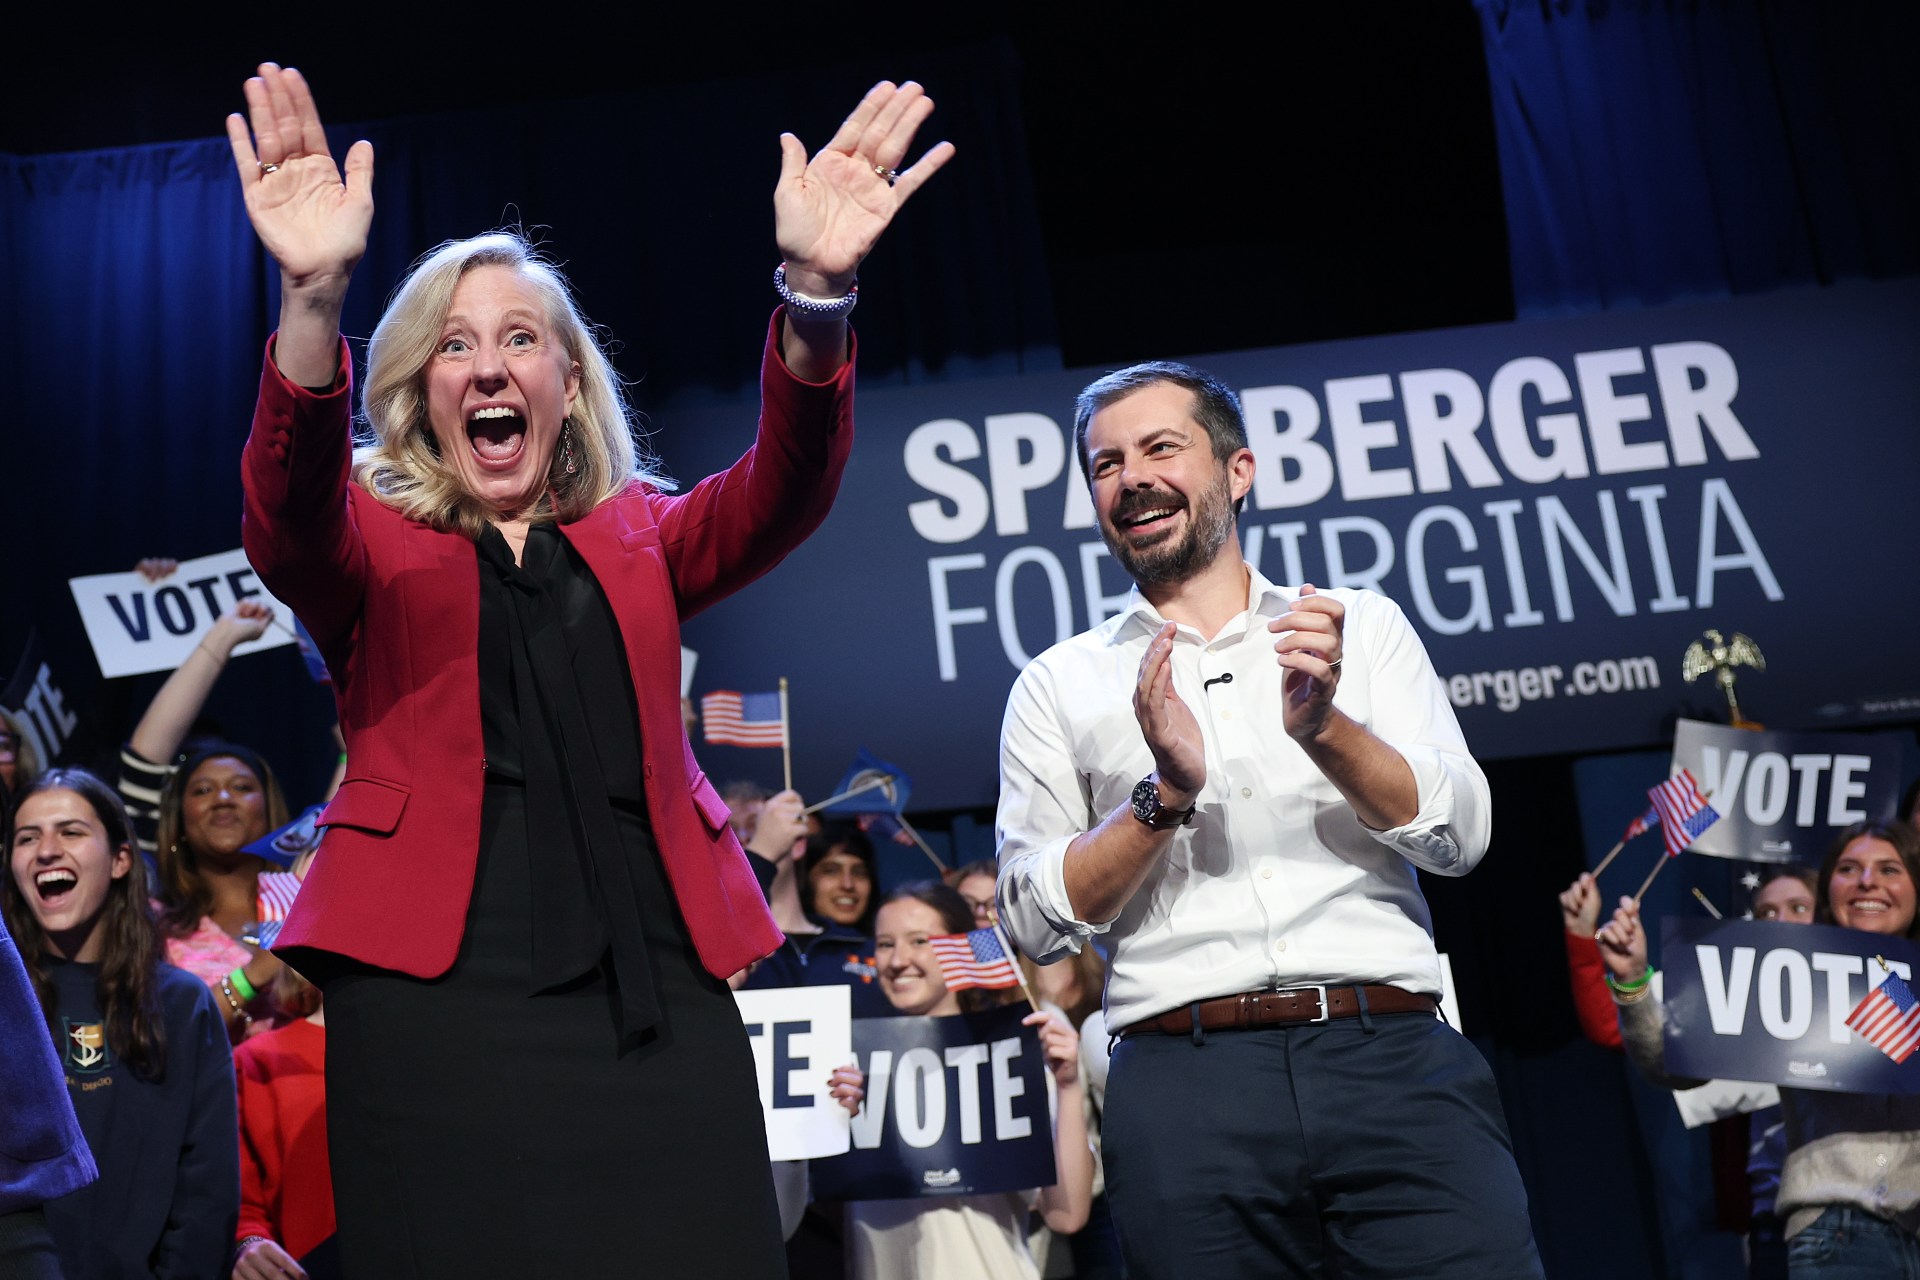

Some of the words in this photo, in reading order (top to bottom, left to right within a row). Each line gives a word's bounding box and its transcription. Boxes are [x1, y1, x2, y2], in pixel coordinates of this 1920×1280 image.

[903, 340, 1761, 544] SPBERGER
[1243, 478, 1785, 636] IRGINIA
[1438, 655, 1661, 712] erger.com
[1702, 745, 1872, 828] VOTE
[851, 1036, 1033, 1149] VOTE
